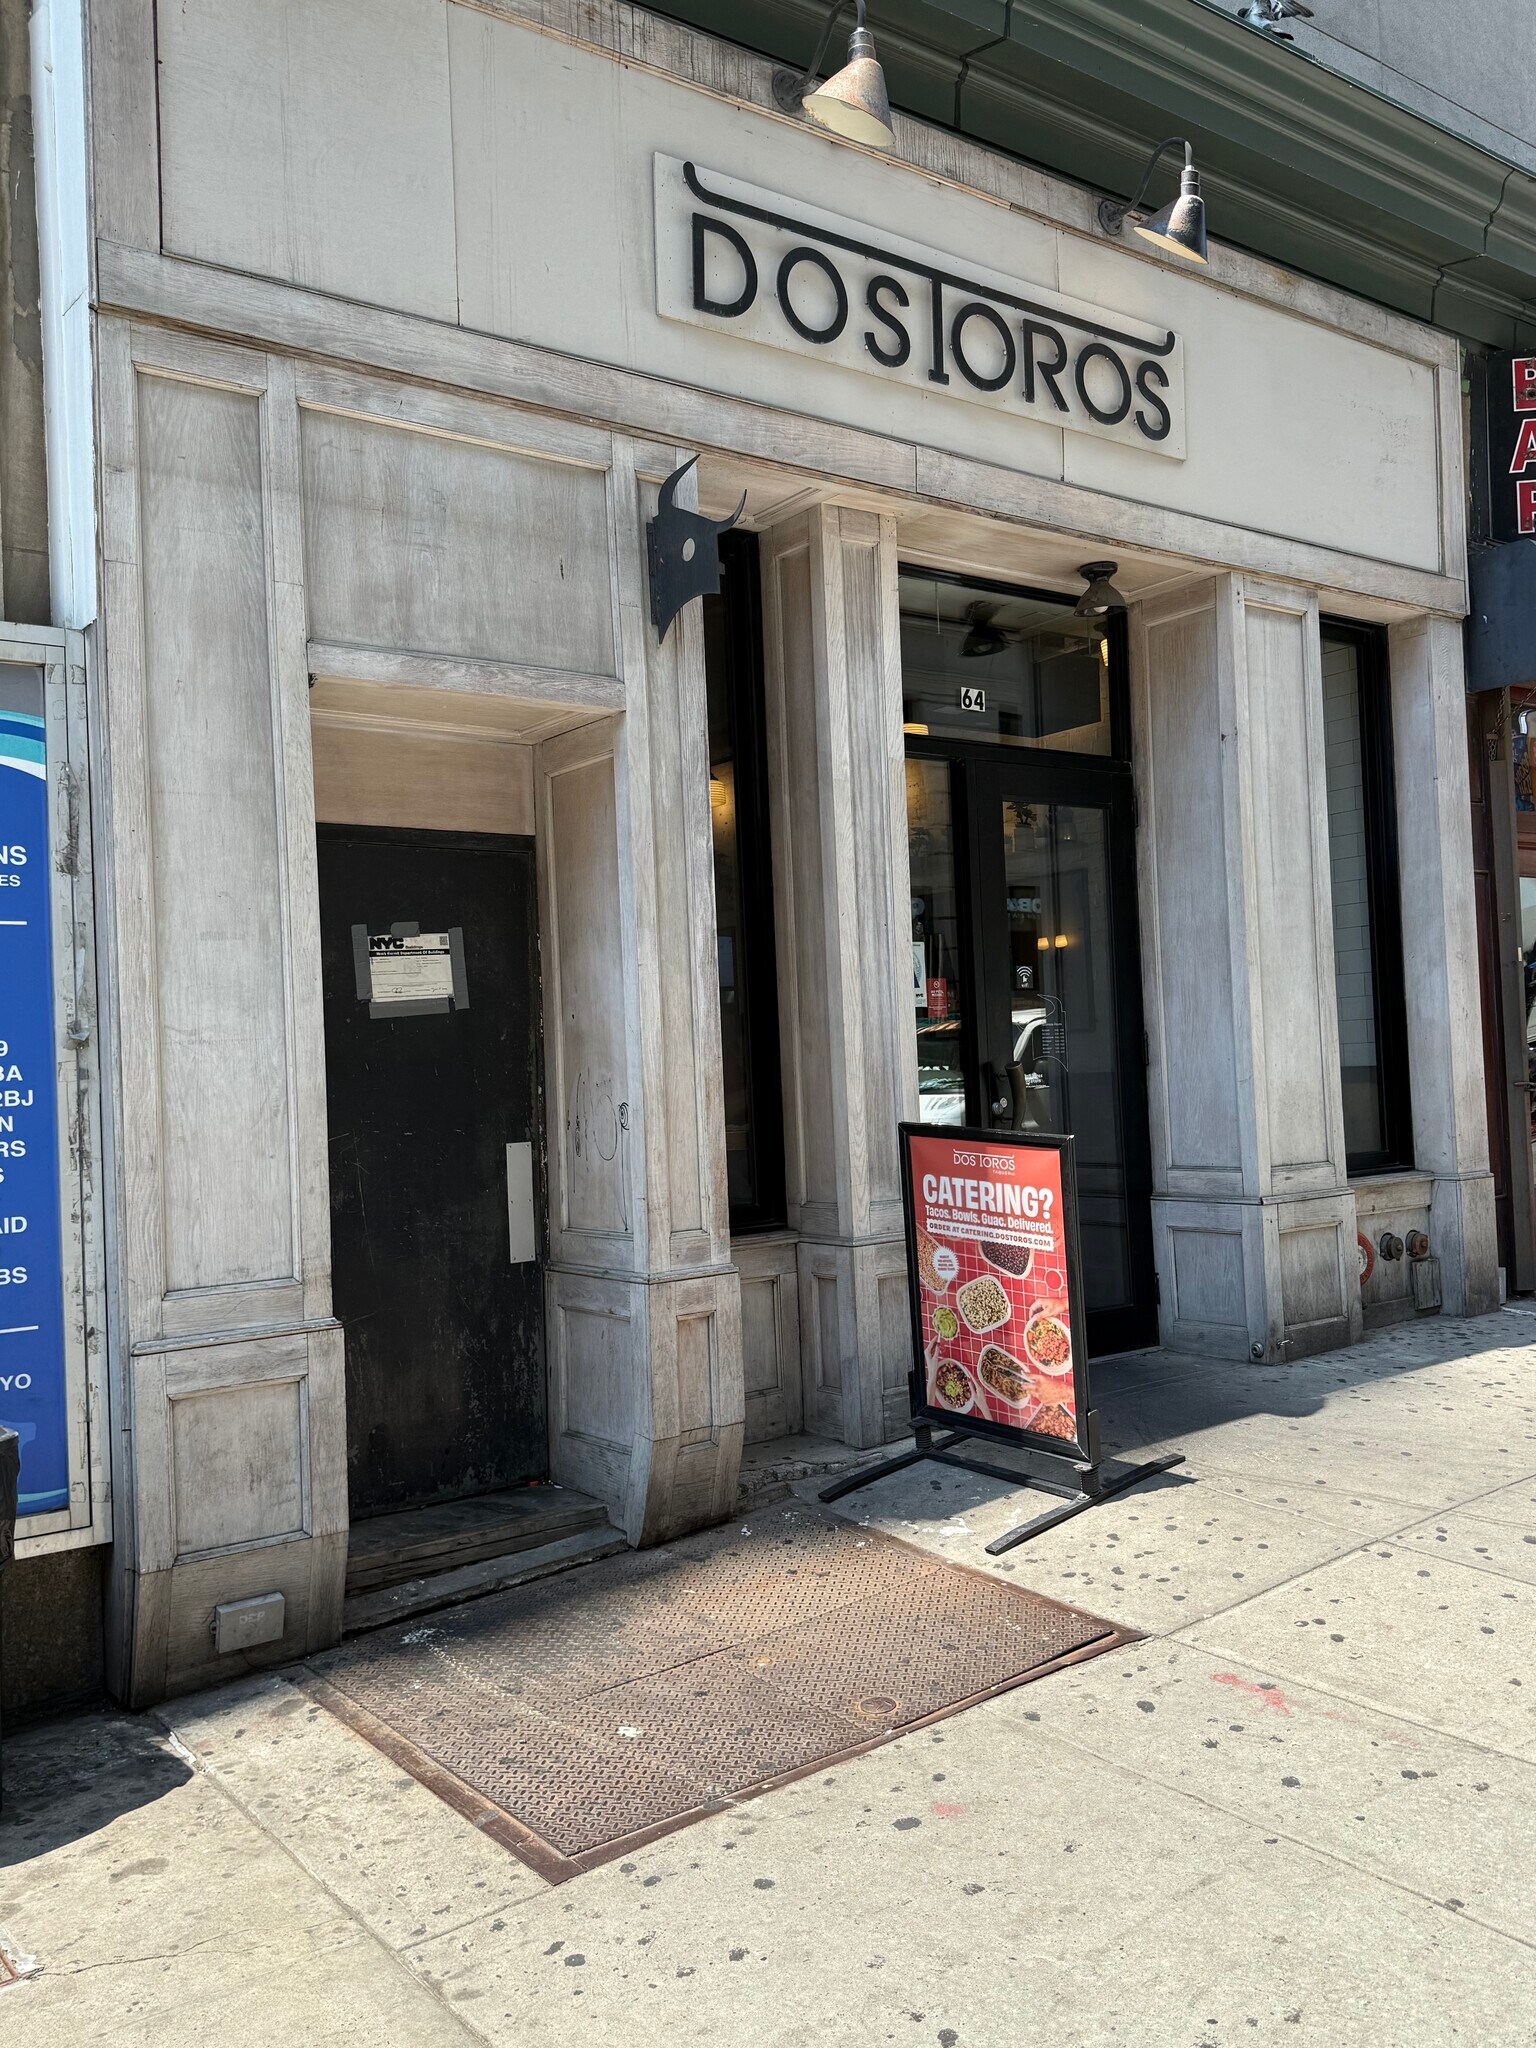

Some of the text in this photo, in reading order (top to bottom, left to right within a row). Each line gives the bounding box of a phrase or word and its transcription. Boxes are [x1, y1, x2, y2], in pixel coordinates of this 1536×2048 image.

[692, 211, 1172, 442] DOS TOROS
[962, 688, 984, 711] 64
[369, 937, 405, 950] NYC
[0, 1064, 24, 1082] A
[0, 1089, 34, 1107] BJ
[953, 1152, 1016, 1171] DOS TOROS
[992, 1169, 1016, 1177] TAQUERIA
[922, 1173, 1054, 1220] CATERING?
[0, 1216, 28, 1234] ID
[925, 1205, 1054, 1234] Tacos. Bowls. Guac. Delivered.
[929, 1222, 1051, 1247] ORDER AT CATERING.DOSTOROS.COM
